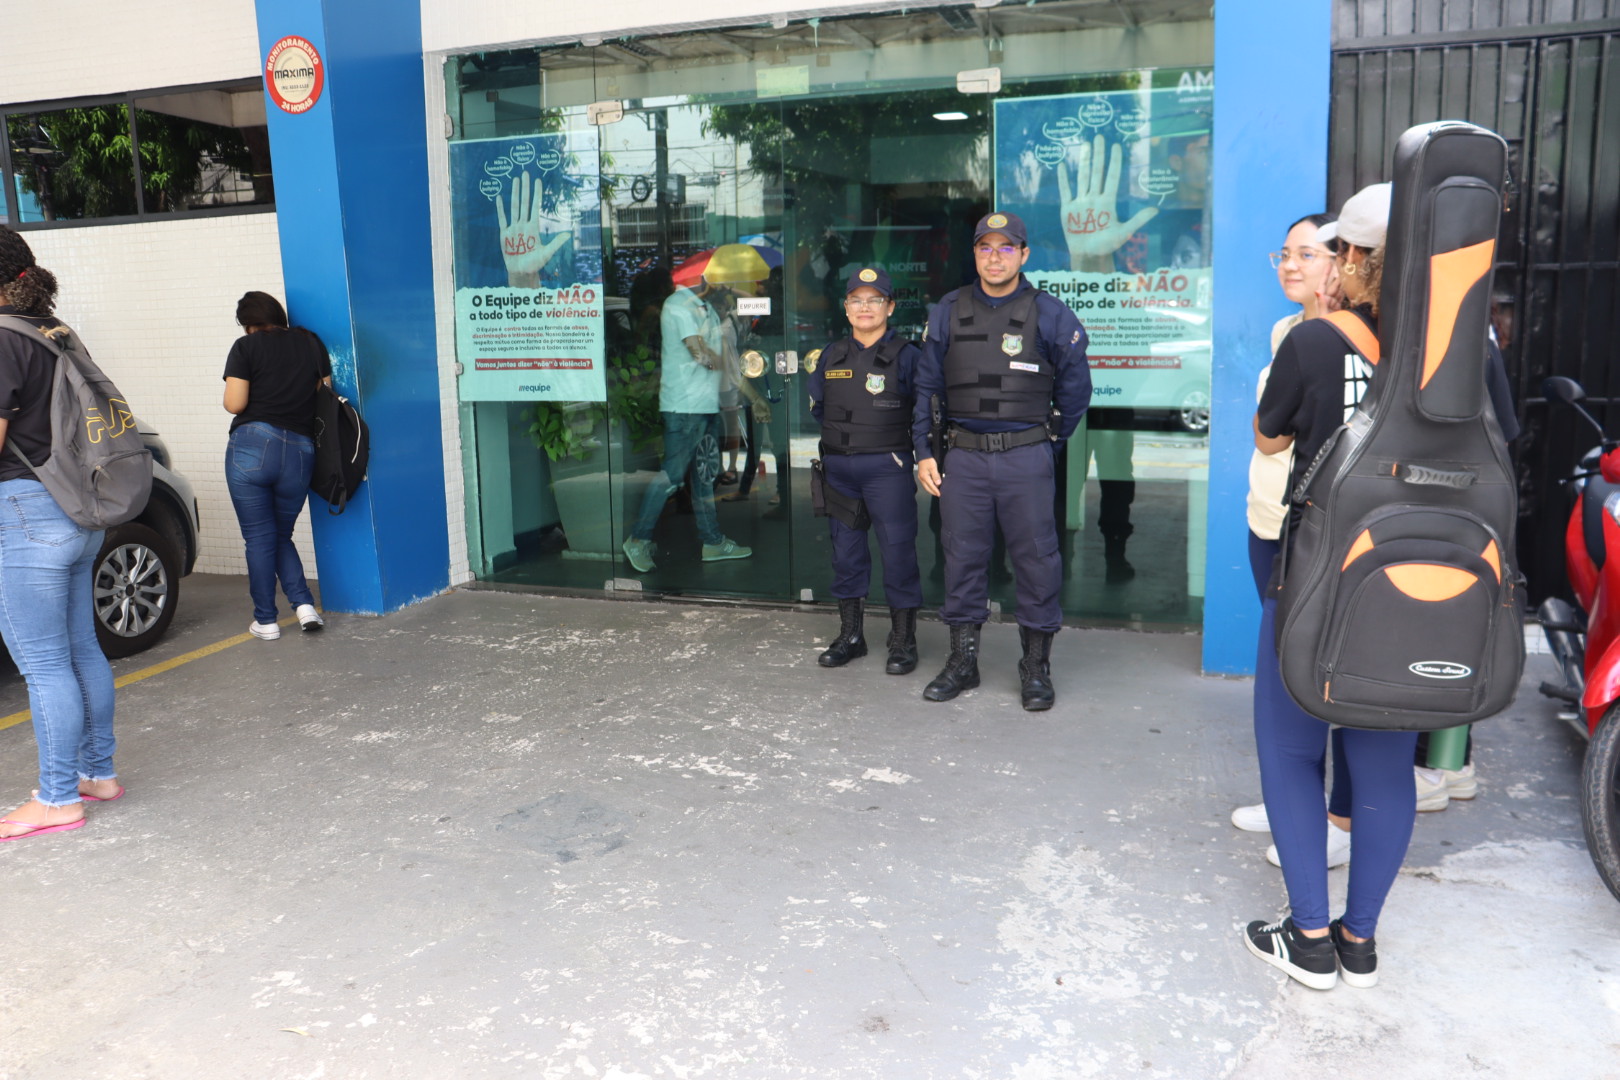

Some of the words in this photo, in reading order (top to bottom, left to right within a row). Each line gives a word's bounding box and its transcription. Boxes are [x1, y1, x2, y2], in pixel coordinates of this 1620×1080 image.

[267, 38, 319, 71] MONITORAMENTO
[274, 67, 314, 79] MAXIMA
[281, 101, 290, 111] 24
[291, 97, 313, 112] HORAS
[1067, 208, 1111, 234] NÃO
[504, 233, 536, 255] NÃO
[889, 262, 927, 272] NORTE
[1038, 278, 1100, 297] Equipe
[1104, 277, 1131, 293] diz
[1136, 270, 1188, 292] NÃO
[472, 295, 483, 307] O
[485, 293, 530, 309] Equipe
[533, 292, 553, 305] diz
[557, 285, 595, 304] NÃO
[1066, 298, 1094, 311] tipo
[1097, 297, 1116, 309] de
[469, 312, 476, 320] a
[478, 311, 503, 320] todo
[506, 309, 527, 321] tipo
[529, 309, 543, 318] de
[546, 307, 600, 318] violência.
[496, 361, 516, 369] juntos
[1128, 358, 1134, 366] à
[1093, 385, 1122, 396] quipe
